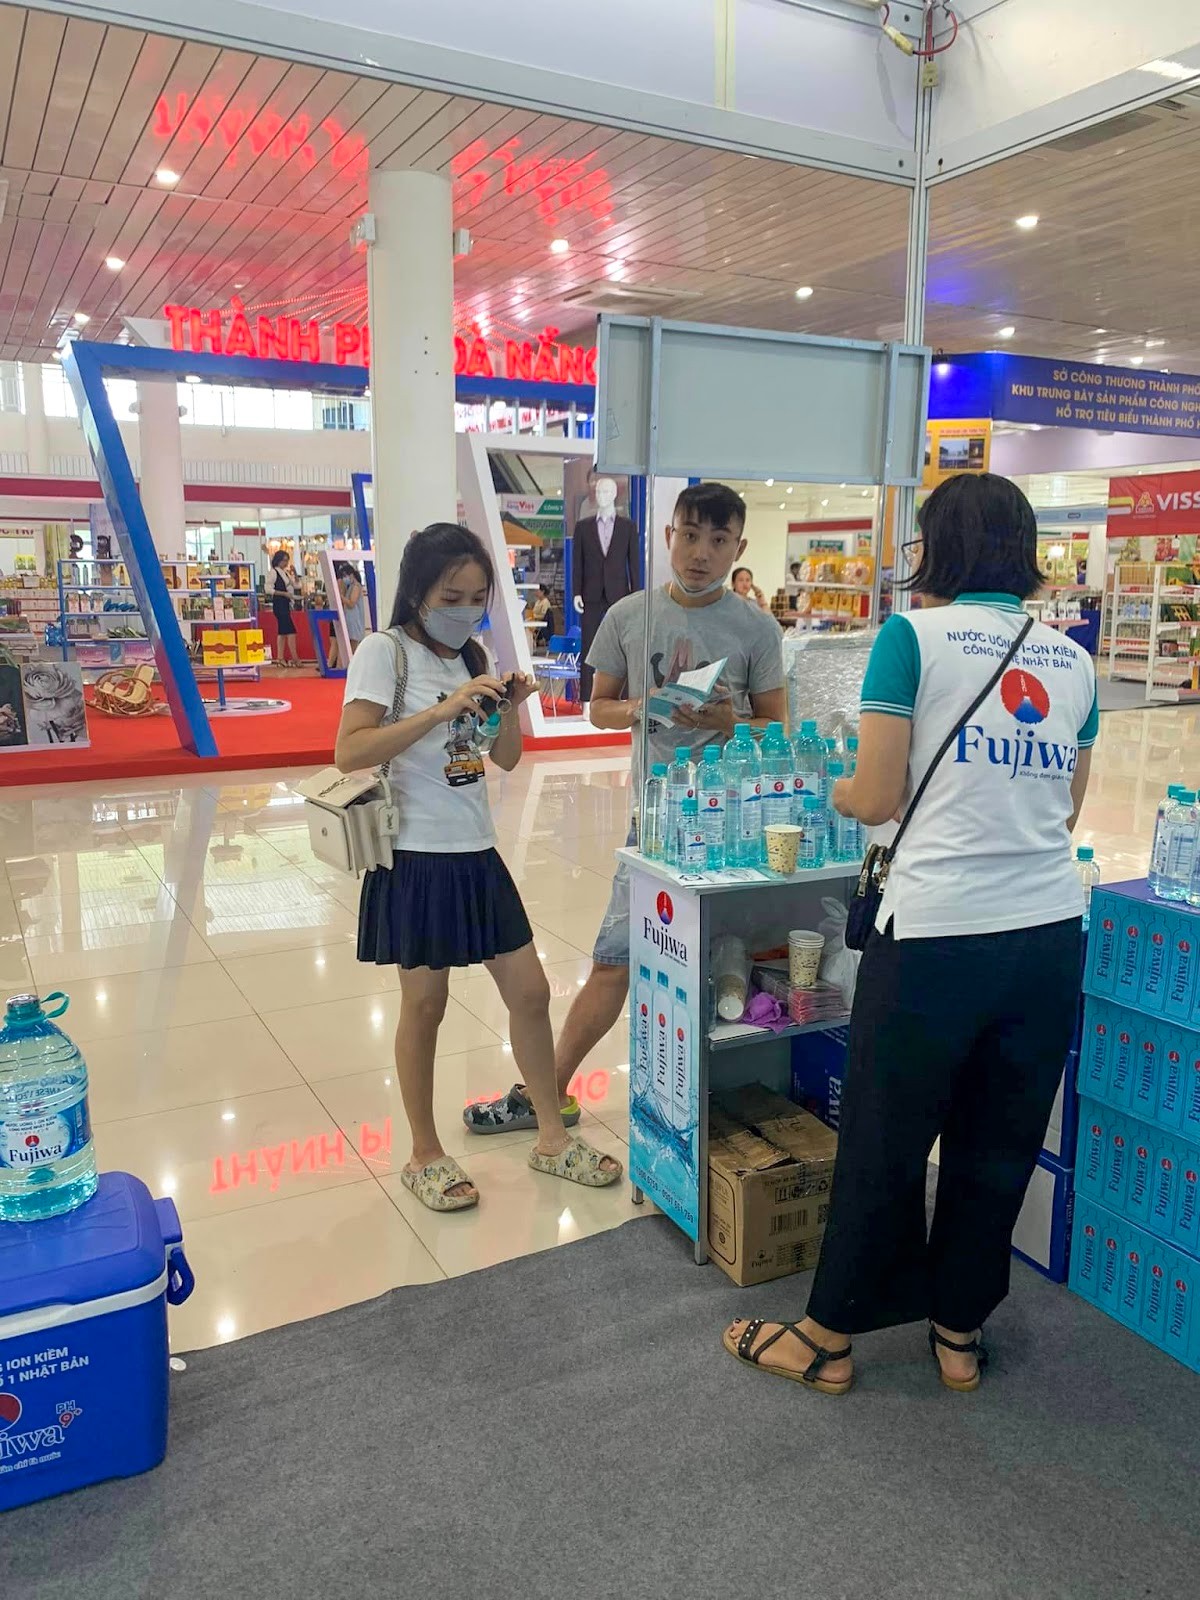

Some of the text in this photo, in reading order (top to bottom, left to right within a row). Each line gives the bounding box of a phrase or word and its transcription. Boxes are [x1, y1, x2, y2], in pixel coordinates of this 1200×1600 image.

[163, 294, 321, 365] THÀNH
[1012, 384, 1034, 396] KHU
[1037, 385, 1072, 399] TRƯNG
[1074, 388, 1094, 402] BÀY
[1096, 391, 1117, 404] SẢN
[1119, 391, 1147, 407] PHẨM
[1150, 396, 1179, 411] CÔNG
[1071, 370, 1102, 385] CÔNG
[1105, 375, 1145, 390] THƯƠNG
[1149, 378, 1180, 394] THÀNH
[1095, 407, 1116, 422] TIÊU
[1141, 411, 1174, 427] THÀNH
[1175, 415, 1195, 429] PHỐ
[947, 628, 1078, 661] NƯỚC UỐN I-ON KIỀM
[963, 645, 994, 657] CÔNG
[1022, 655, 1050, 669] NHẬT
[1053, 657, 1073, 670] BẢN
[953, 725, 1077, 780] Fujiwa
[643, 916, 688, 961] Fujiwa
[1097, 933, 1112, 978] Fujiwa
[1121, 940, 1137, 986] Fujiwa
[1145, 947, 1162, 994] Fujiwa
[1171, 955, 1188, 1002] Fujiwa
[657, 1030, 668, 1087] Fujiwa
[675, 1044, 687, 1099] Fujiwa
[1113, 1046, 1128, 1091] Fujiwa
[1138, 1054, 1154, 1101] Fujiwa
[1163, 1064, 1179, 1112] Fujiwa
[9, 1144, 62, 1165] Fujiwa
[1087, 1138, 1101, 1181] Fujiwa
[1108, 1149, 1124, 1193] Fujiwa
[1132, 1160, 1147, 1205] Fujiwa
[1155, 1172, 1170, 1218] Fujiwa
[1179, 1184, 1195, 1231] Fujiwa
[1169, 1293, 1185, 1338] Fujiwa
[6, 1355, 31, 1371] ION
[34, 1346, 69, 1365] KIỀM
[8, 1375, 15, 1384] 1
[19, 1363, 58, 1382] NHẬT
[60, 1355, 90, 1372] BẢN
[0, 1424, 65, 1459] iwa
